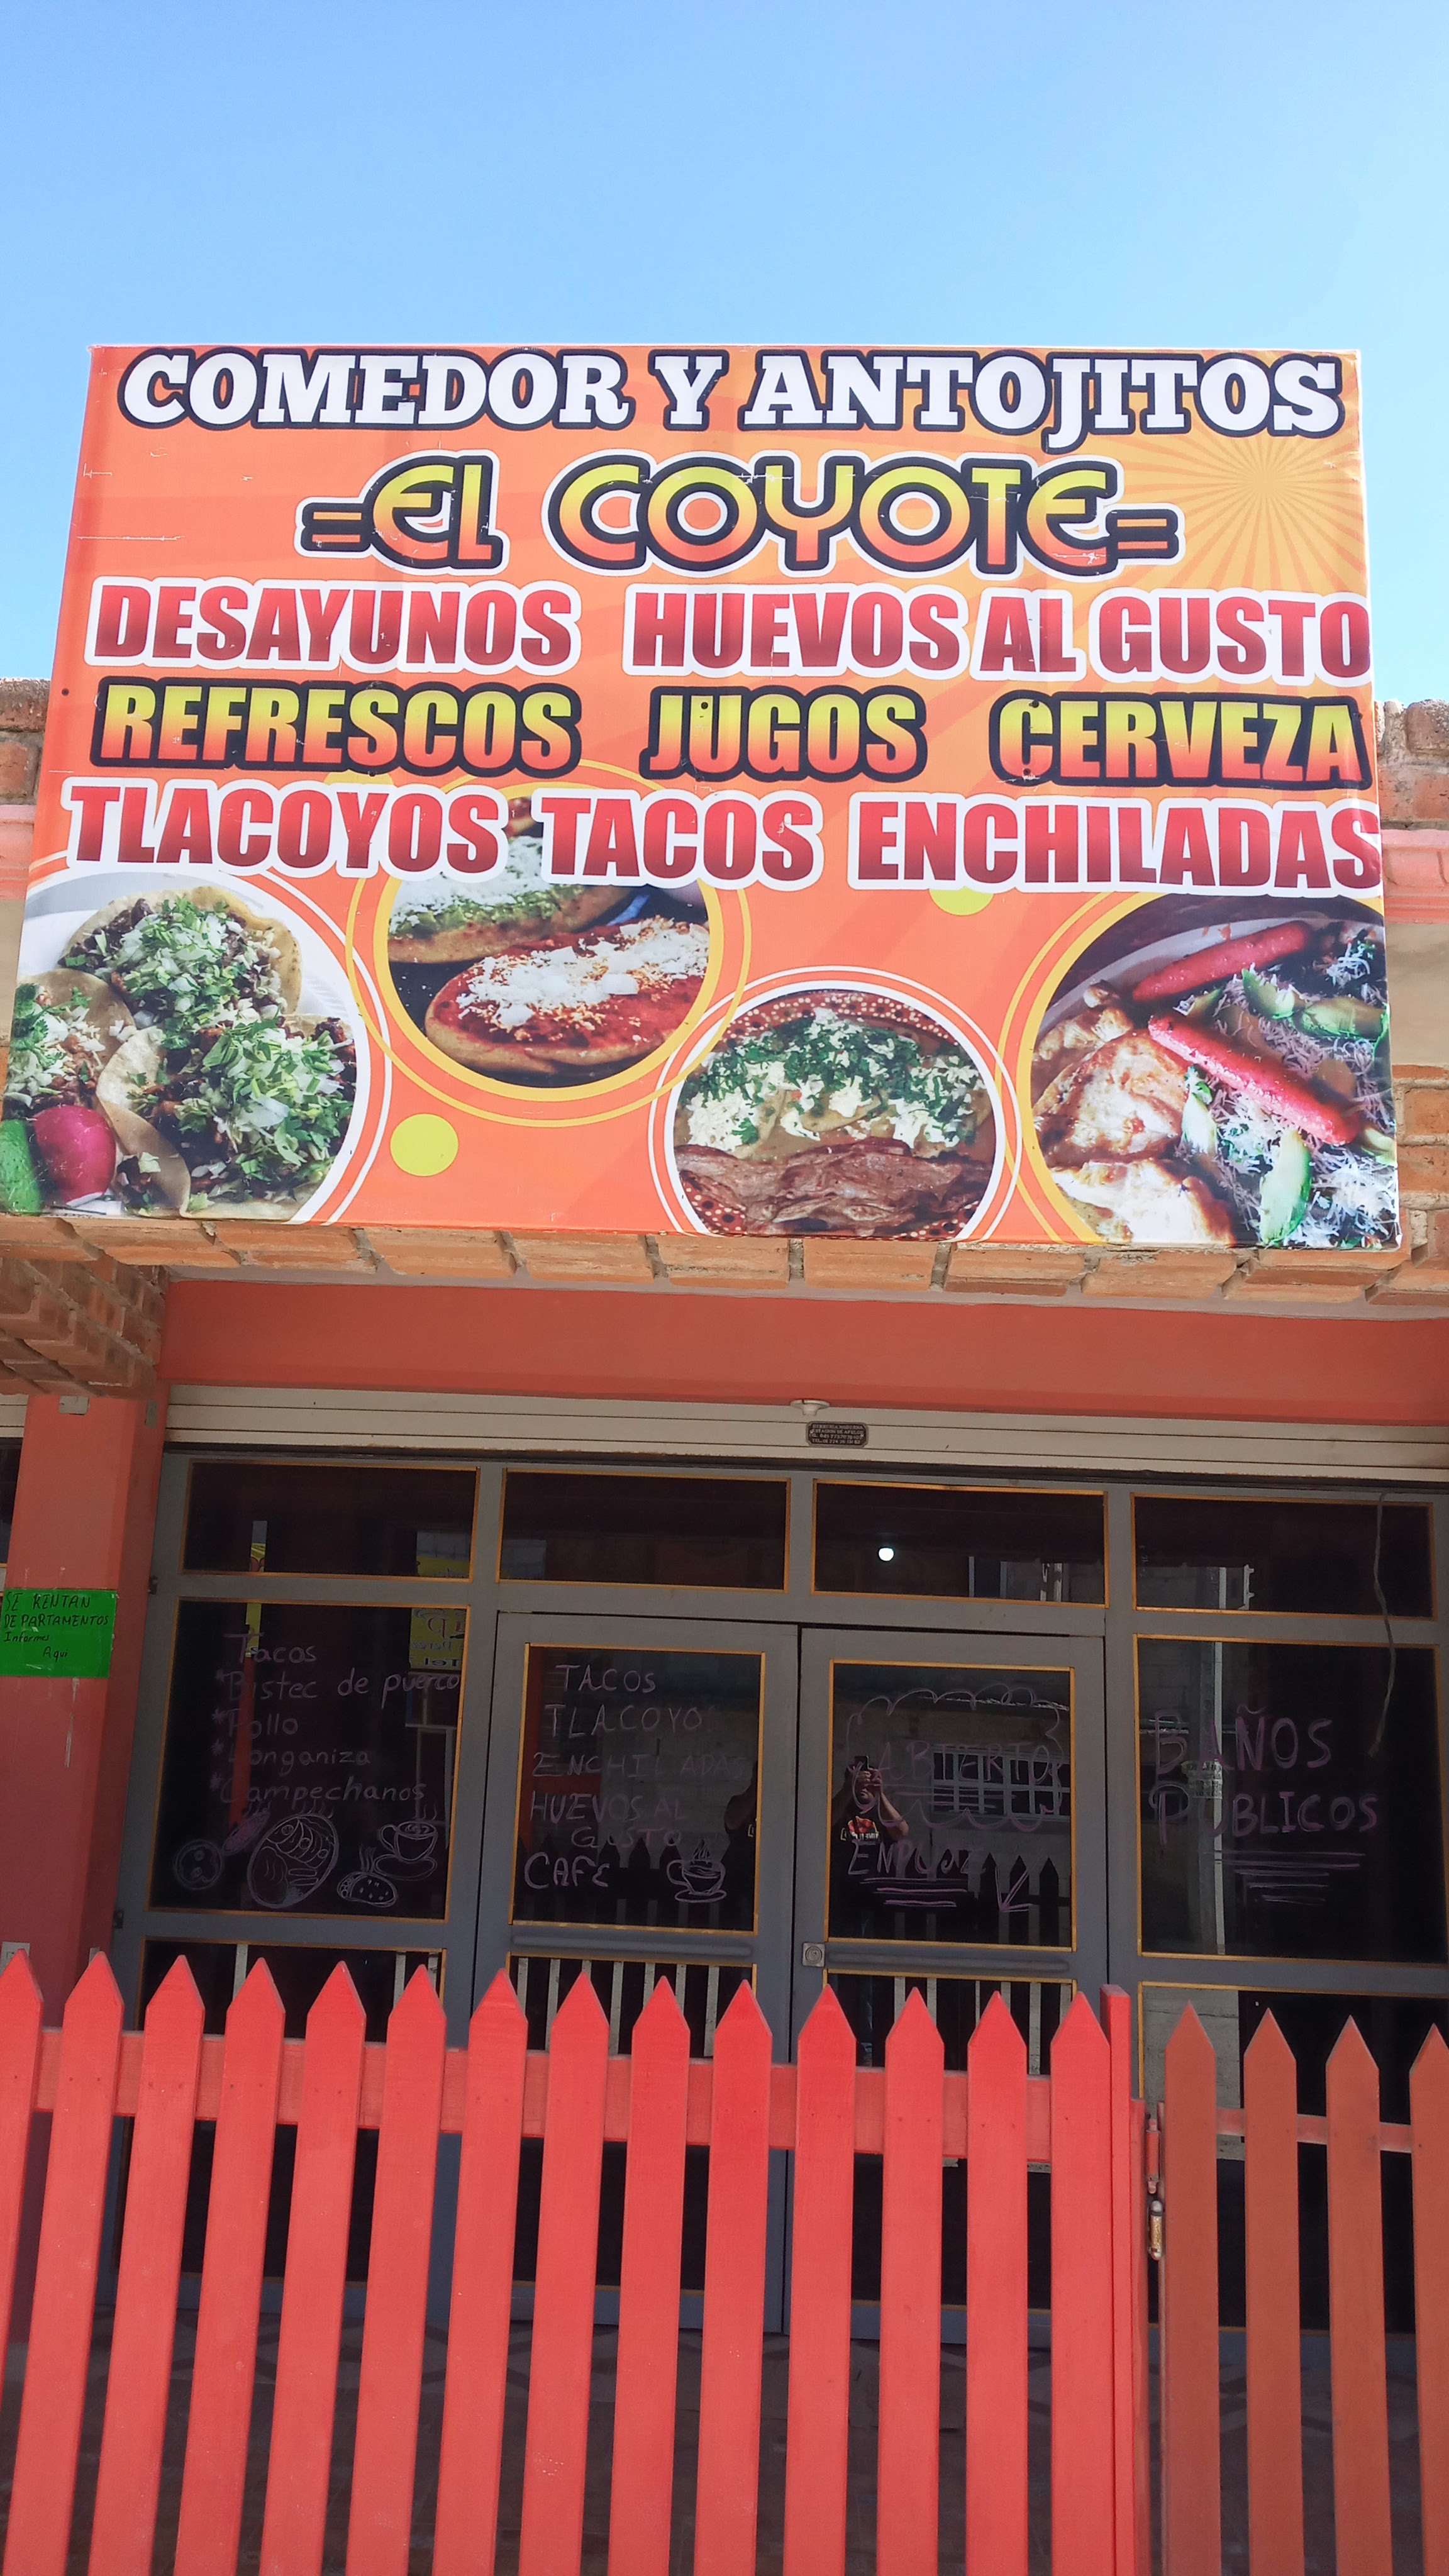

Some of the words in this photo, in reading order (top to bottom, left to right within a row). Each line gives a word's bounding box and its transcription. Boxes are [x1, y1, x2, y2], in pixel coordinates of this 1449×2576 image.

[121, 350, 631, 429] COMEDOR
[651, 352, 726, 429] Y
[741, 352, 1341, 452] ANTOJITOS
[369, 459, 499, 566] EL
[553, 459, 1112, 571] COYOTE
[90, 581, 576, 670] DESAYUNOS
[628, 587, 963, 673] HUEVOS
[975, 594, 1080, 676] AL
[1096, 592, 1372, 682] GUSTO
[96, 680, 575, 772] REFRESCOS
[645, 691, 921, 777] JUGOS
[994, 695, 1366, 785] CERVEZA
[67, 782, 502, 877] TLACOYOS
[537, 793, 818, 884] TACOS
[853, 797, 1382, 892] ENCHILADAS
[6, 1592, 23, 1611] SE
[32, 1593, 91, 1609] RENTAN
[4, 1631, 50, 1643] Informes
[224, 1631, 318, 1664] Tacos
[337, 1667, 370, 1696] de
[381, 1673, 460, 1709] puerco
[555, 1664, 656, 1694] TACOS
[226, 1707, 299, 1740] Pollo
[1154, 1704, 1333, 1776] BAÑOS
[219, 1775, 427, 1804] Campechanos
[530, 1790, 644, 1824] HUEVOS
[570, 1826, 682, 1849] GUSTO
